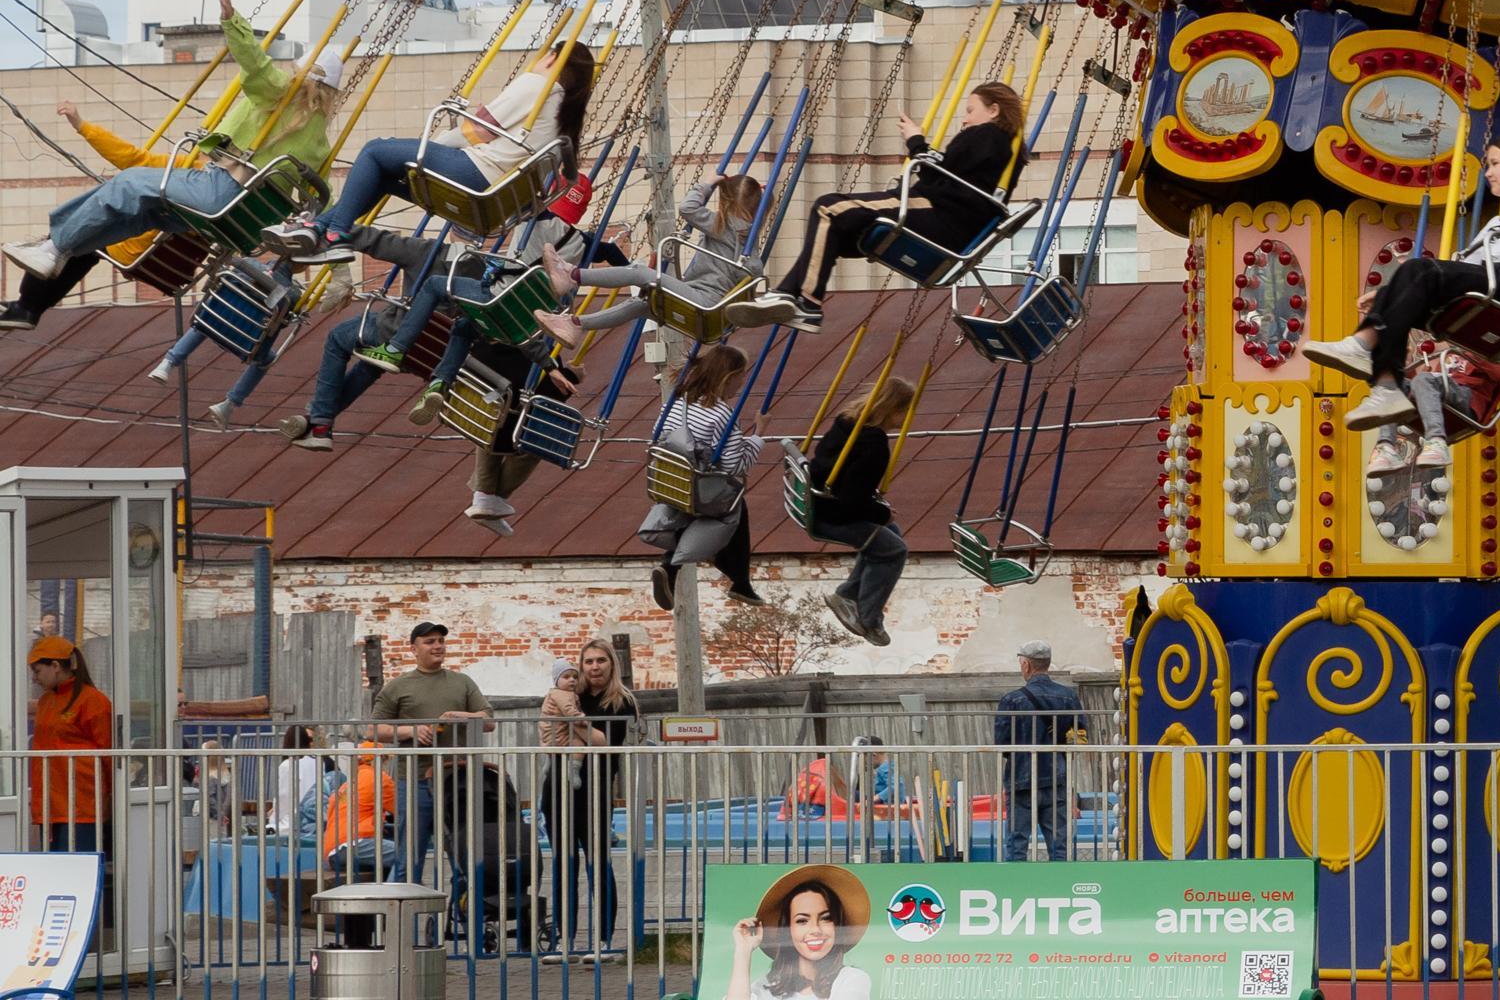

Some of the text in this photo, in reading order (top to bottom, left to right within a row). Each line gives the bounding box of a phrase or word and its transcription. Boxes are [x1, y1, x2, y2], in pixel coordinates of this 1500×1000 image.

[1183, 888, 1295, 904] больше, чем
[959, 889, 1103, 936] Вита
[1155, 907, 1296, 934] аптека
[900, 953, 1013, 964] 8 800 100 72 72
[1045, 952, 1132, 963] vita-nord.ru
[1165, 952, 1227, 963] vitanord
